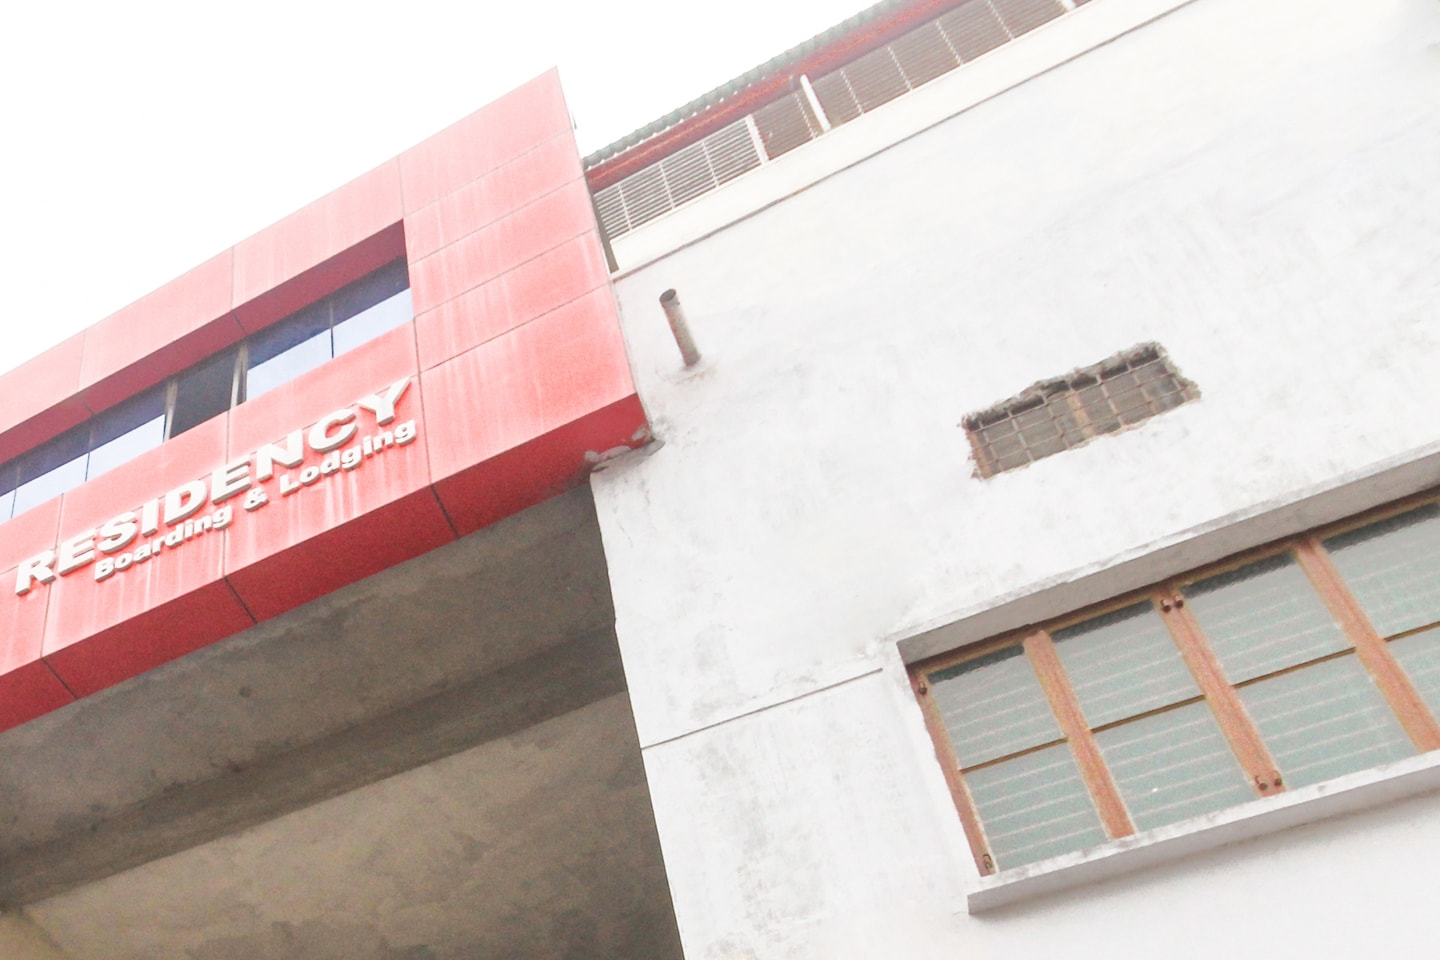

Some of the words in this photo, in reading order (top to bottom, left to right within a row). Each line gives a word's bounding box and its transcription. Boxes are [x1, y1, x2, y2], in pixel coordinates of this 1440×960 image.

[15, 376, 412, 595] RESIDENCY
[94, 505, 232, 582] Boarding
[244, 486, 269, 510] &
[280, 419, 416, 497] Lodging
